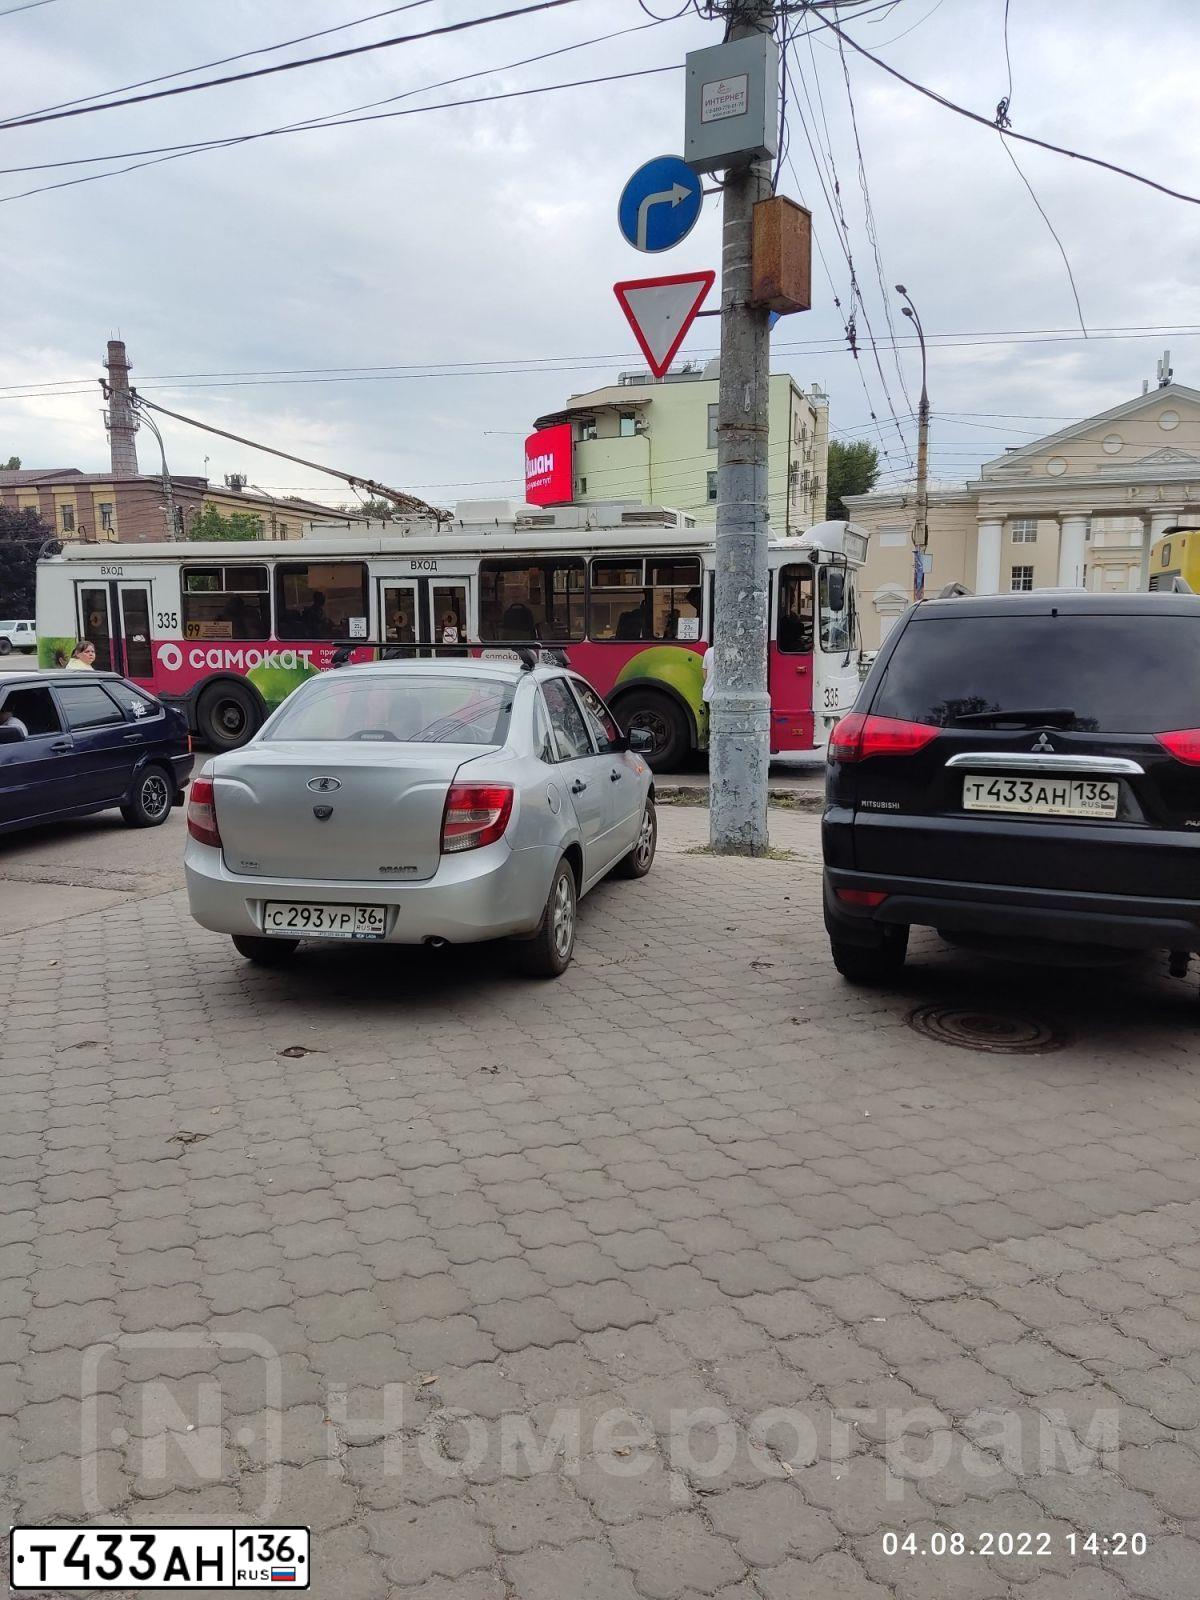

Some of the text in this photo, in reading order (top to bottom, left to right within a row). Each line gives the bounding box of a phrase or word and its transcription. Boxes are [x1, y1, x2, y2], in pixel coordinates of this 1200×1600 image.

[705, 92, 744, 106] ИНТЕРНЕТ
[101, 566, 123, 576] ВХОД
[410, 560, 437, 571] ВХОД
[157, 612, 178, 629] 335
[187, 623, 200, 637] 99
[188, 649, 313, 670] самокат
[485, 652, 521, 660] samoka
[824, 688, 839, 708] 335
[972, 780, 1110, 805] Т433АН 136
[861, 800, 900, 809] MITSUBISHI
[1081, 801, 1100, 809] RUS
[273, 907, 377, 929] С293УР 36
